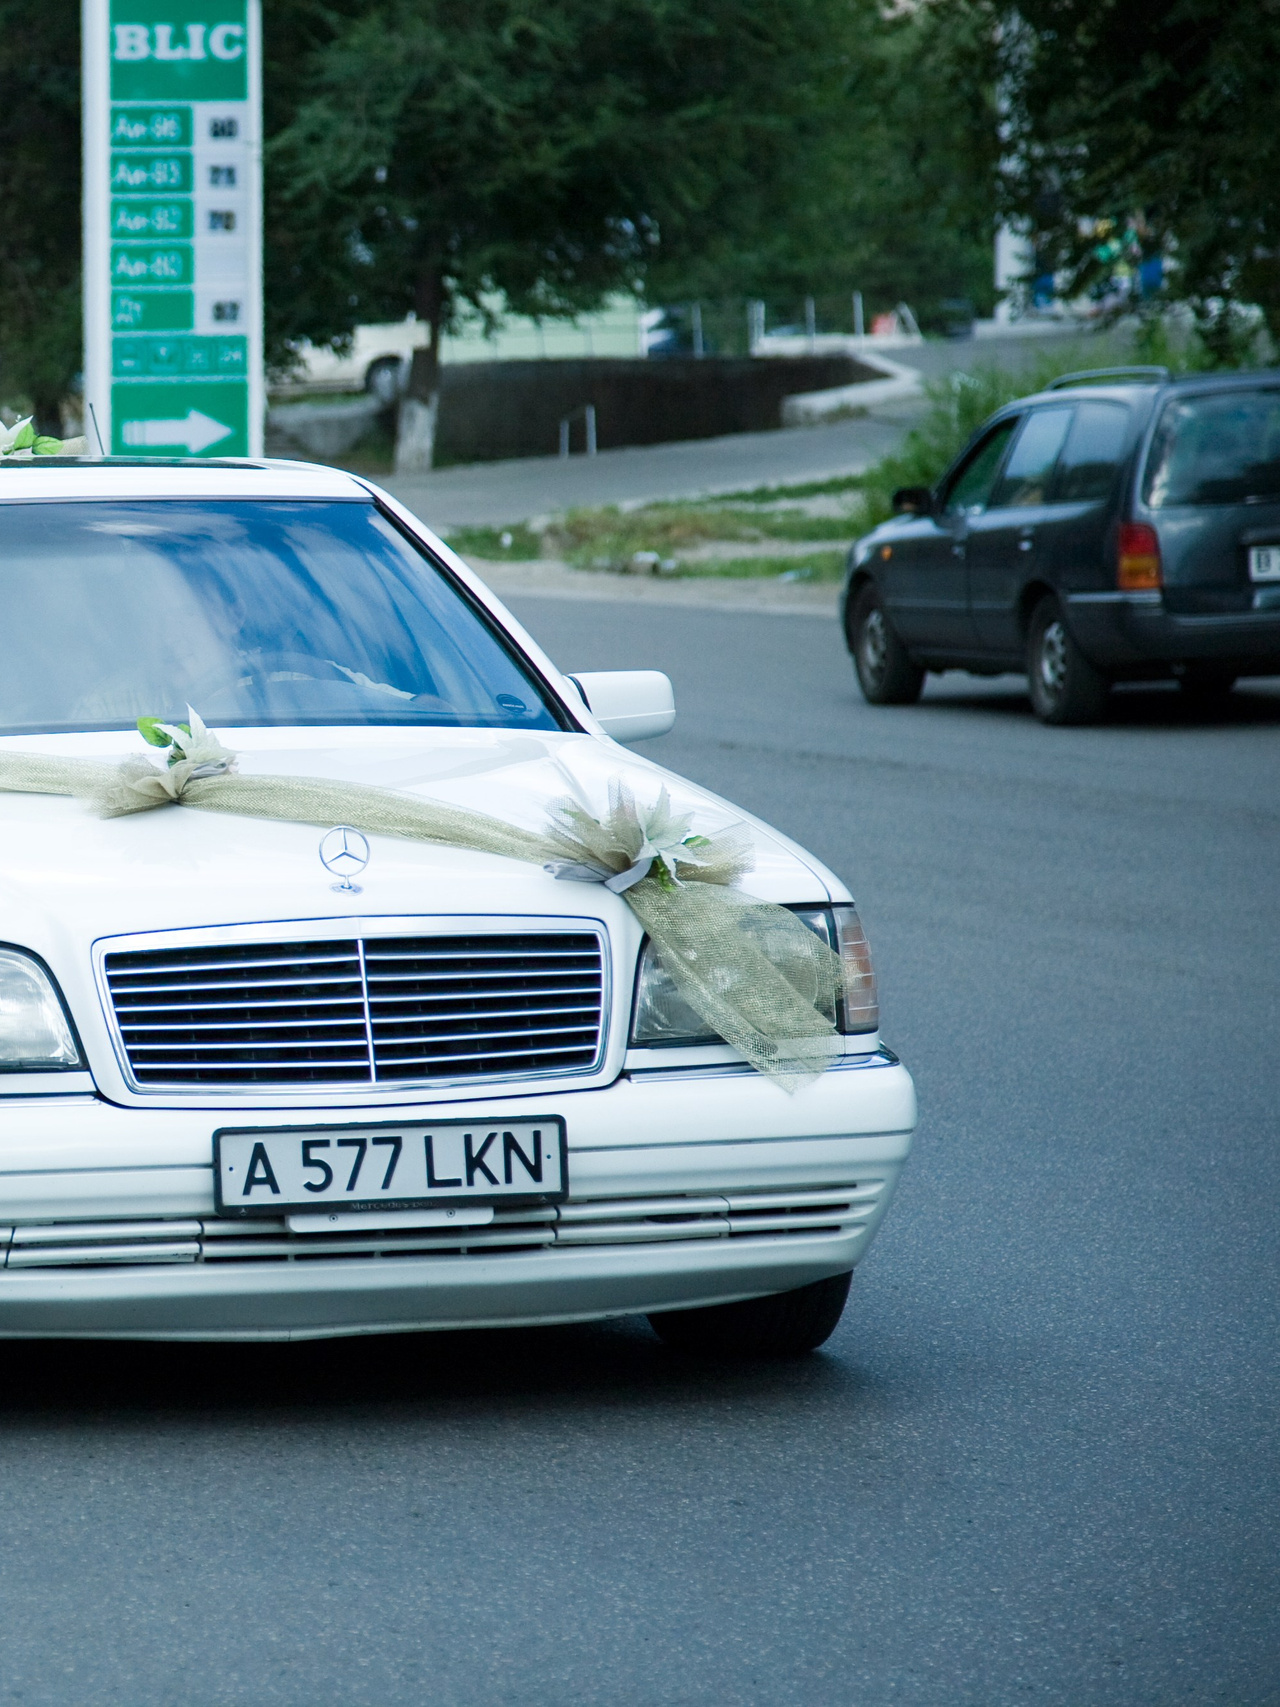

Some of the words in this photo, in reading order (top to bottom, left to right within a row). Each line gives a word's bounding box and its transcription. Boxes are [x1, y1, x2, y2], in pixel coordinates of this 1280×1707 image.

[114, 24, 244, 60] BLIC
[242, 1141, 281, 1196] A
[301, 1135, 403, 1193] 577
[424, 1129, 543, 1189] LKN
